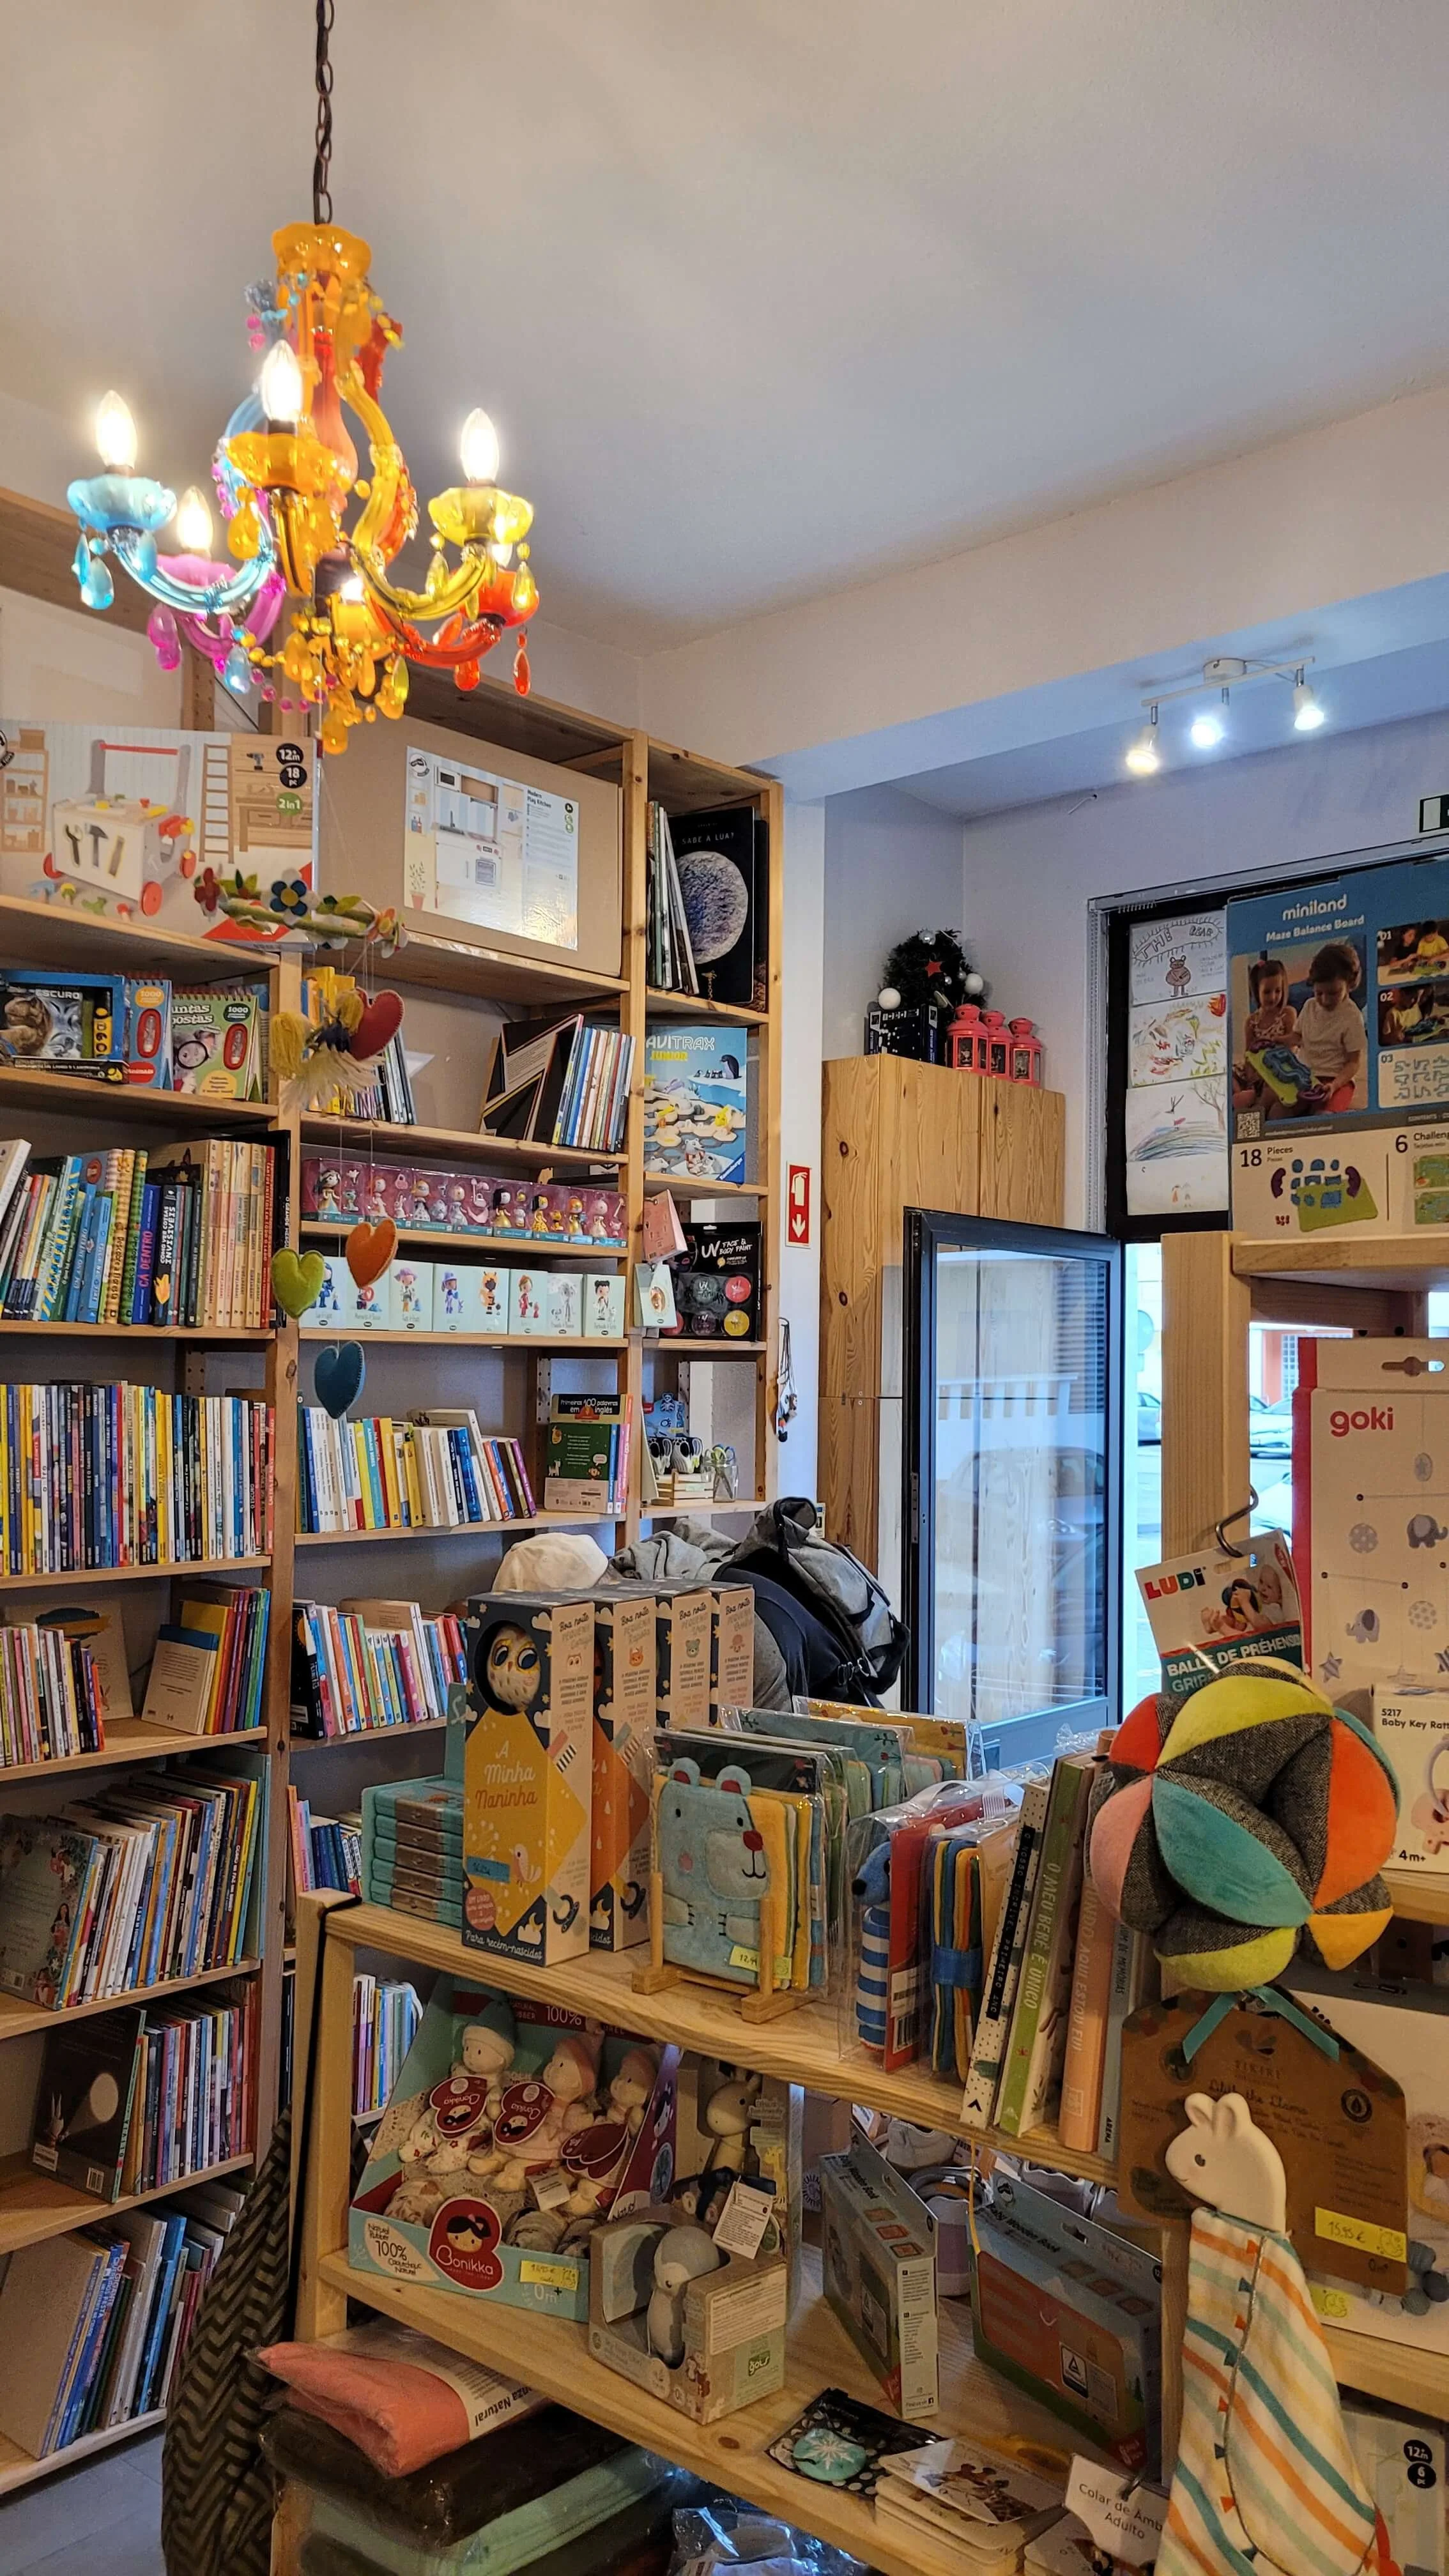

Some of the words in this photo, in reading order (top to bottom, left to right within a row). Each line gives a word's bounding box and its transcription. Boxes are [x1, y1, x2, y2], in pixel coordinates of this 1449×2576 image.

[286, 767, 300, 779] 18
[682, 836, 702, 845] SABE
[1282, 894, 1347, 921] miniland
[1266, 929, 1291, 942] Maze
[1293, 923, 1332, 937] Balance
[1334, 915, 1365, 930] Board
[36, 990, 80, 1000] ESCURO
[1380, 992, 1393, 1002] 02
[172, 1004, 211, 1014] untas
[172, 1015, 213, 1028] postas
[645, 1036, 715, 1050] AVITRAX
[1381, 1054, 1393, 1063] 03
[1395, 1134, 1408, 1153] 6
[1413, 1131, 1449, 1142] Challeng
[1240, 1149, 1262, 1167] 18
[1267, 1146, 1294, 1154] Pieces
[165, 1206, 176, 1265] INVISÍVEIS
[115, 1236, 124, 1266] Descobre
[141, 1230, 153, 1270] DENTRO
[702, 1240, 721, 1258] UV
[723, 1239, 739, 1248] FACE
[719, 1246, 734, 1255] BODY
[111, 1272, 121, 1300] floresta
[583, 1398, 596, 1407] 100
[1330, 1406, 1393, 1438] goki
[620, 1615, 633, 1626] Boa
[634, 1606, 649, 1620] noite
[679, 1610, 691, 1620] Boa
[693, 1602, 707, 1616] noite
[726, 1606, 737, 1615] Boa
[738, 1597, 751, 1609] noite
[1217, 1648, 1238, 1664] DE
[1381, 1708, 1402, 1717] 5217
[1382, 1718, 1406, 1729] Baby
[1409, 1719, 1427, 1730] Key
[1430, 1721, 1449, 1729] Ratt
[484, 1763, 535, 1786] Minha
[475, 1788, 537, 1810] Naninha
[1048, 1862, 1062, 1873] O
[1041, 1874, 1059, 1910] MEU
[1034, 1915, 1052, 1949] BEBÉ
[465, 1929, 484, 1946] Para
[486, 1937, 542, 1960] recém-nascidos
[1078, 1945, 1091, 1975] AQUI
[1023, 1967, 1044, 2009] ÚNICO
[1073, 1981, 1086, 2027] ESTOU
[546, 2005, 583, 2026] 100%
[118, 2119, 130, 2159] OLIVIA
[368, 2223, 390, 2235] Natural
[369, 2232, 389, 2241] Rubber
[375, 2240, 408, 2261] 100%
[436, 2244, 494, 2276] Bonikka
[96, 2296, 109, 2319] FESTA
[511, 2386, 533, 2401] nza
[475, 2396, 511, 2427] Natural
[1417, 2466, 1425, 2477] 6
[1078, 2483, 1111, 2505] Colar
[1114, 2502, 1130, 2516] de
[1134, 2508, 1163, 2531] Âmb
[1105, 2512, 1145, 2539] Adulto
